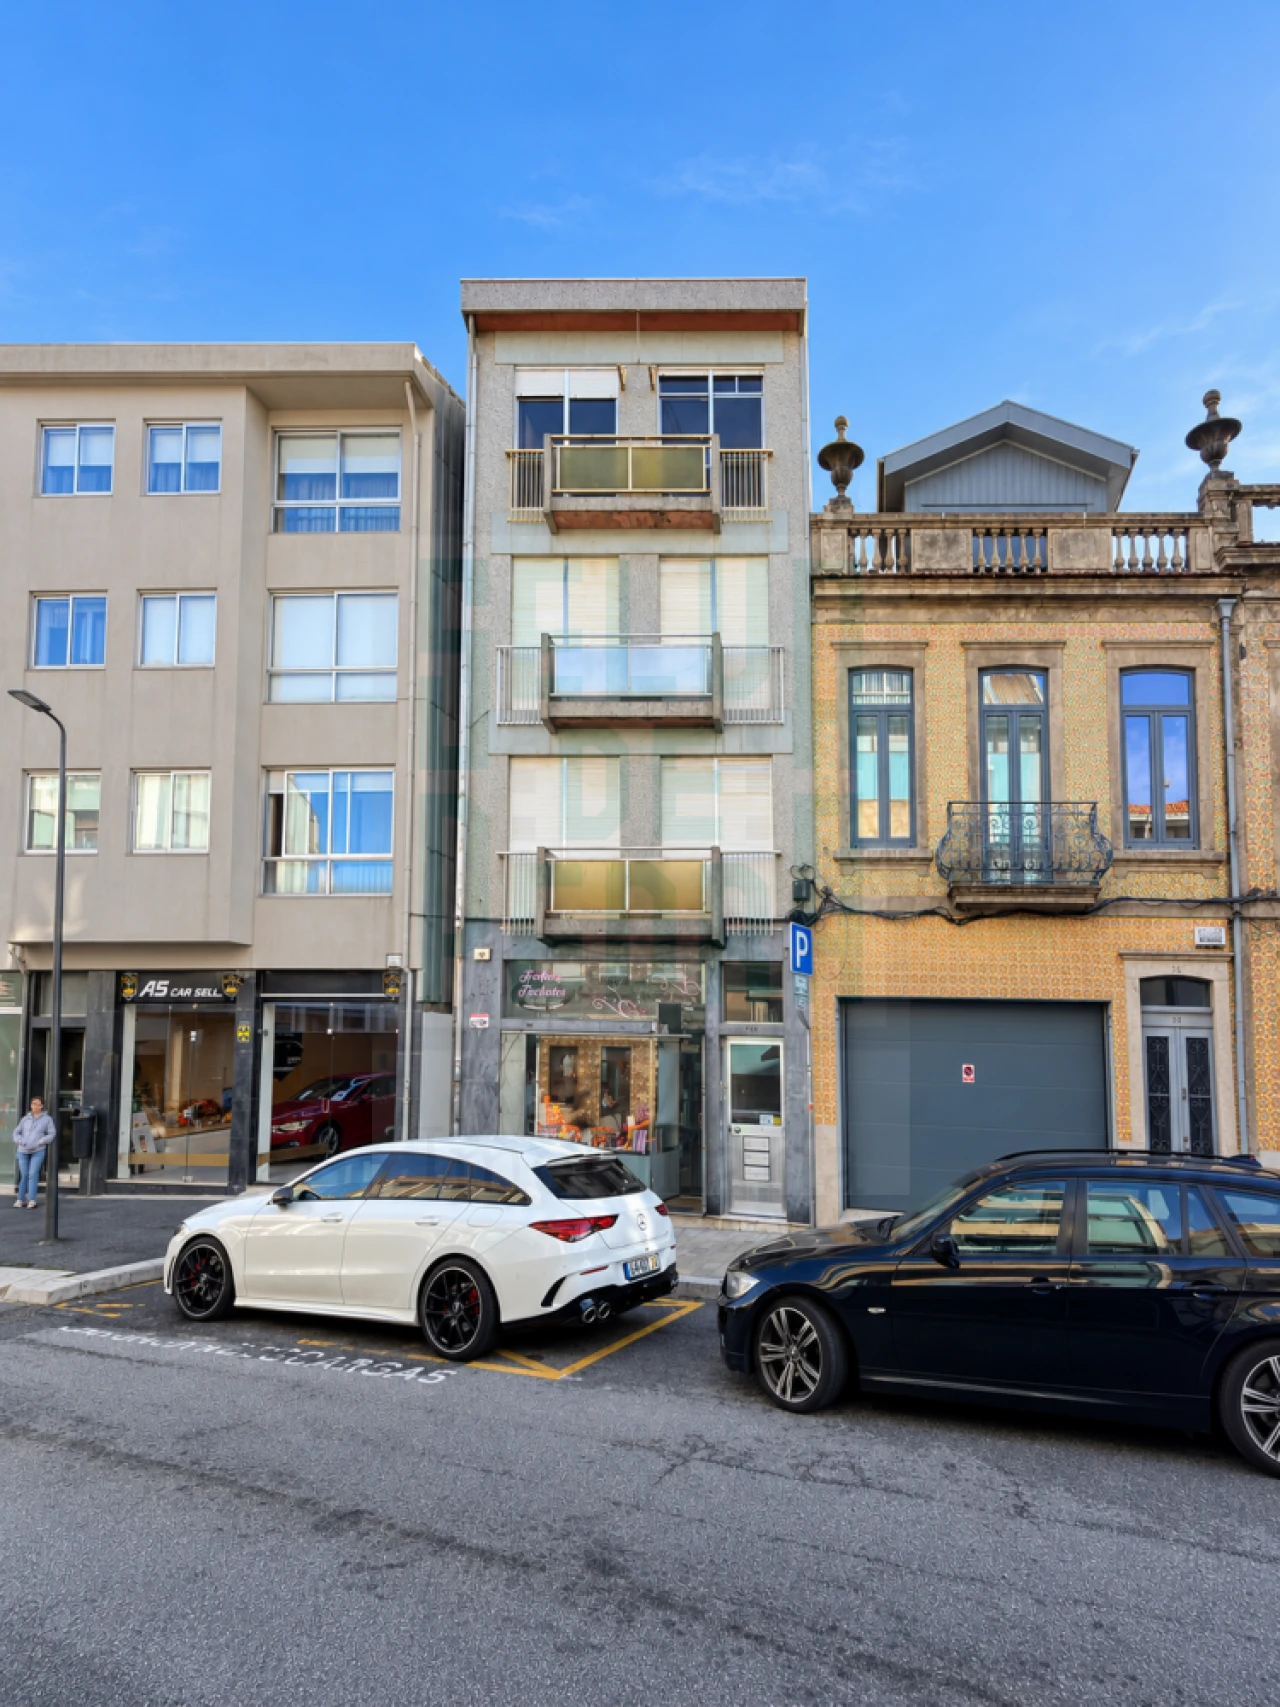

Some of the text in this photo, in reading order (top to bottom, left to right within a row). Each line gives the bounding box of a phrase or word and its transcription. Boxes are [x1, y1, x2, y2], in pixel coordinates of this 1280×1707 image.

[796, 930, 808, 969] P
[170, 988, 192, 998] CAR
[193, 988, 223, 998] SELL
